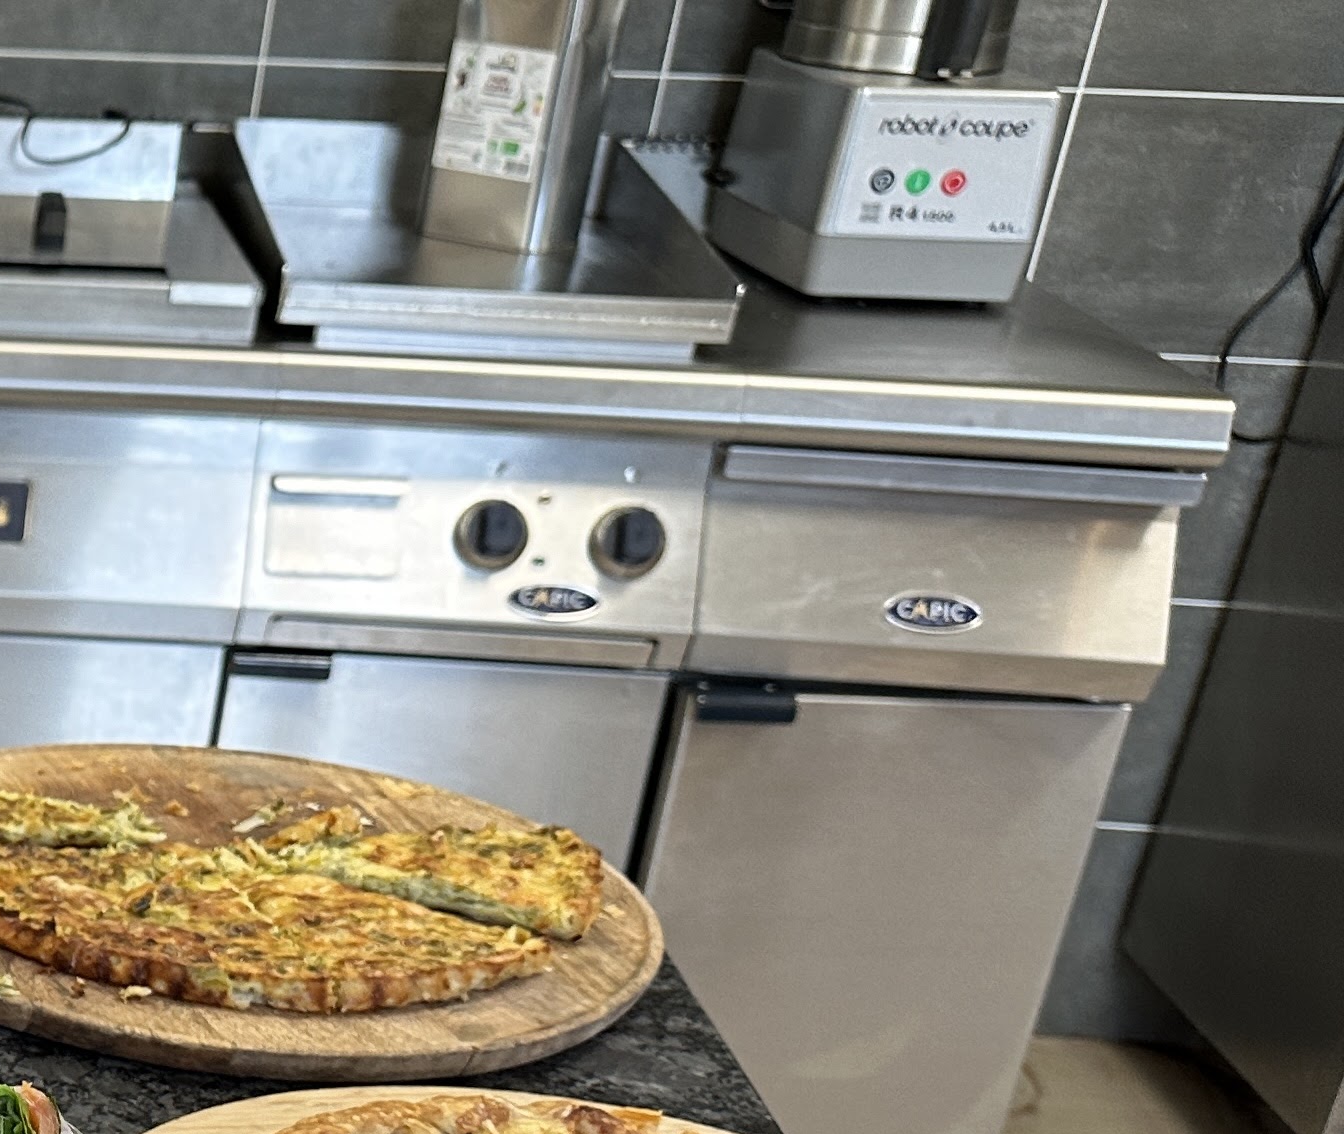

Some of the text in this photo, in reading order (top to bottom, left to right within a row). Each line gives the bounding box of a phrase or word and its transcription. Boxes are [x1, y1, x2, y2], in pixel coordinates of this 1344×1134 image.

[878, 113, 1030, 142] robot coupe
[896, 599, 969, 624] CAPIC
